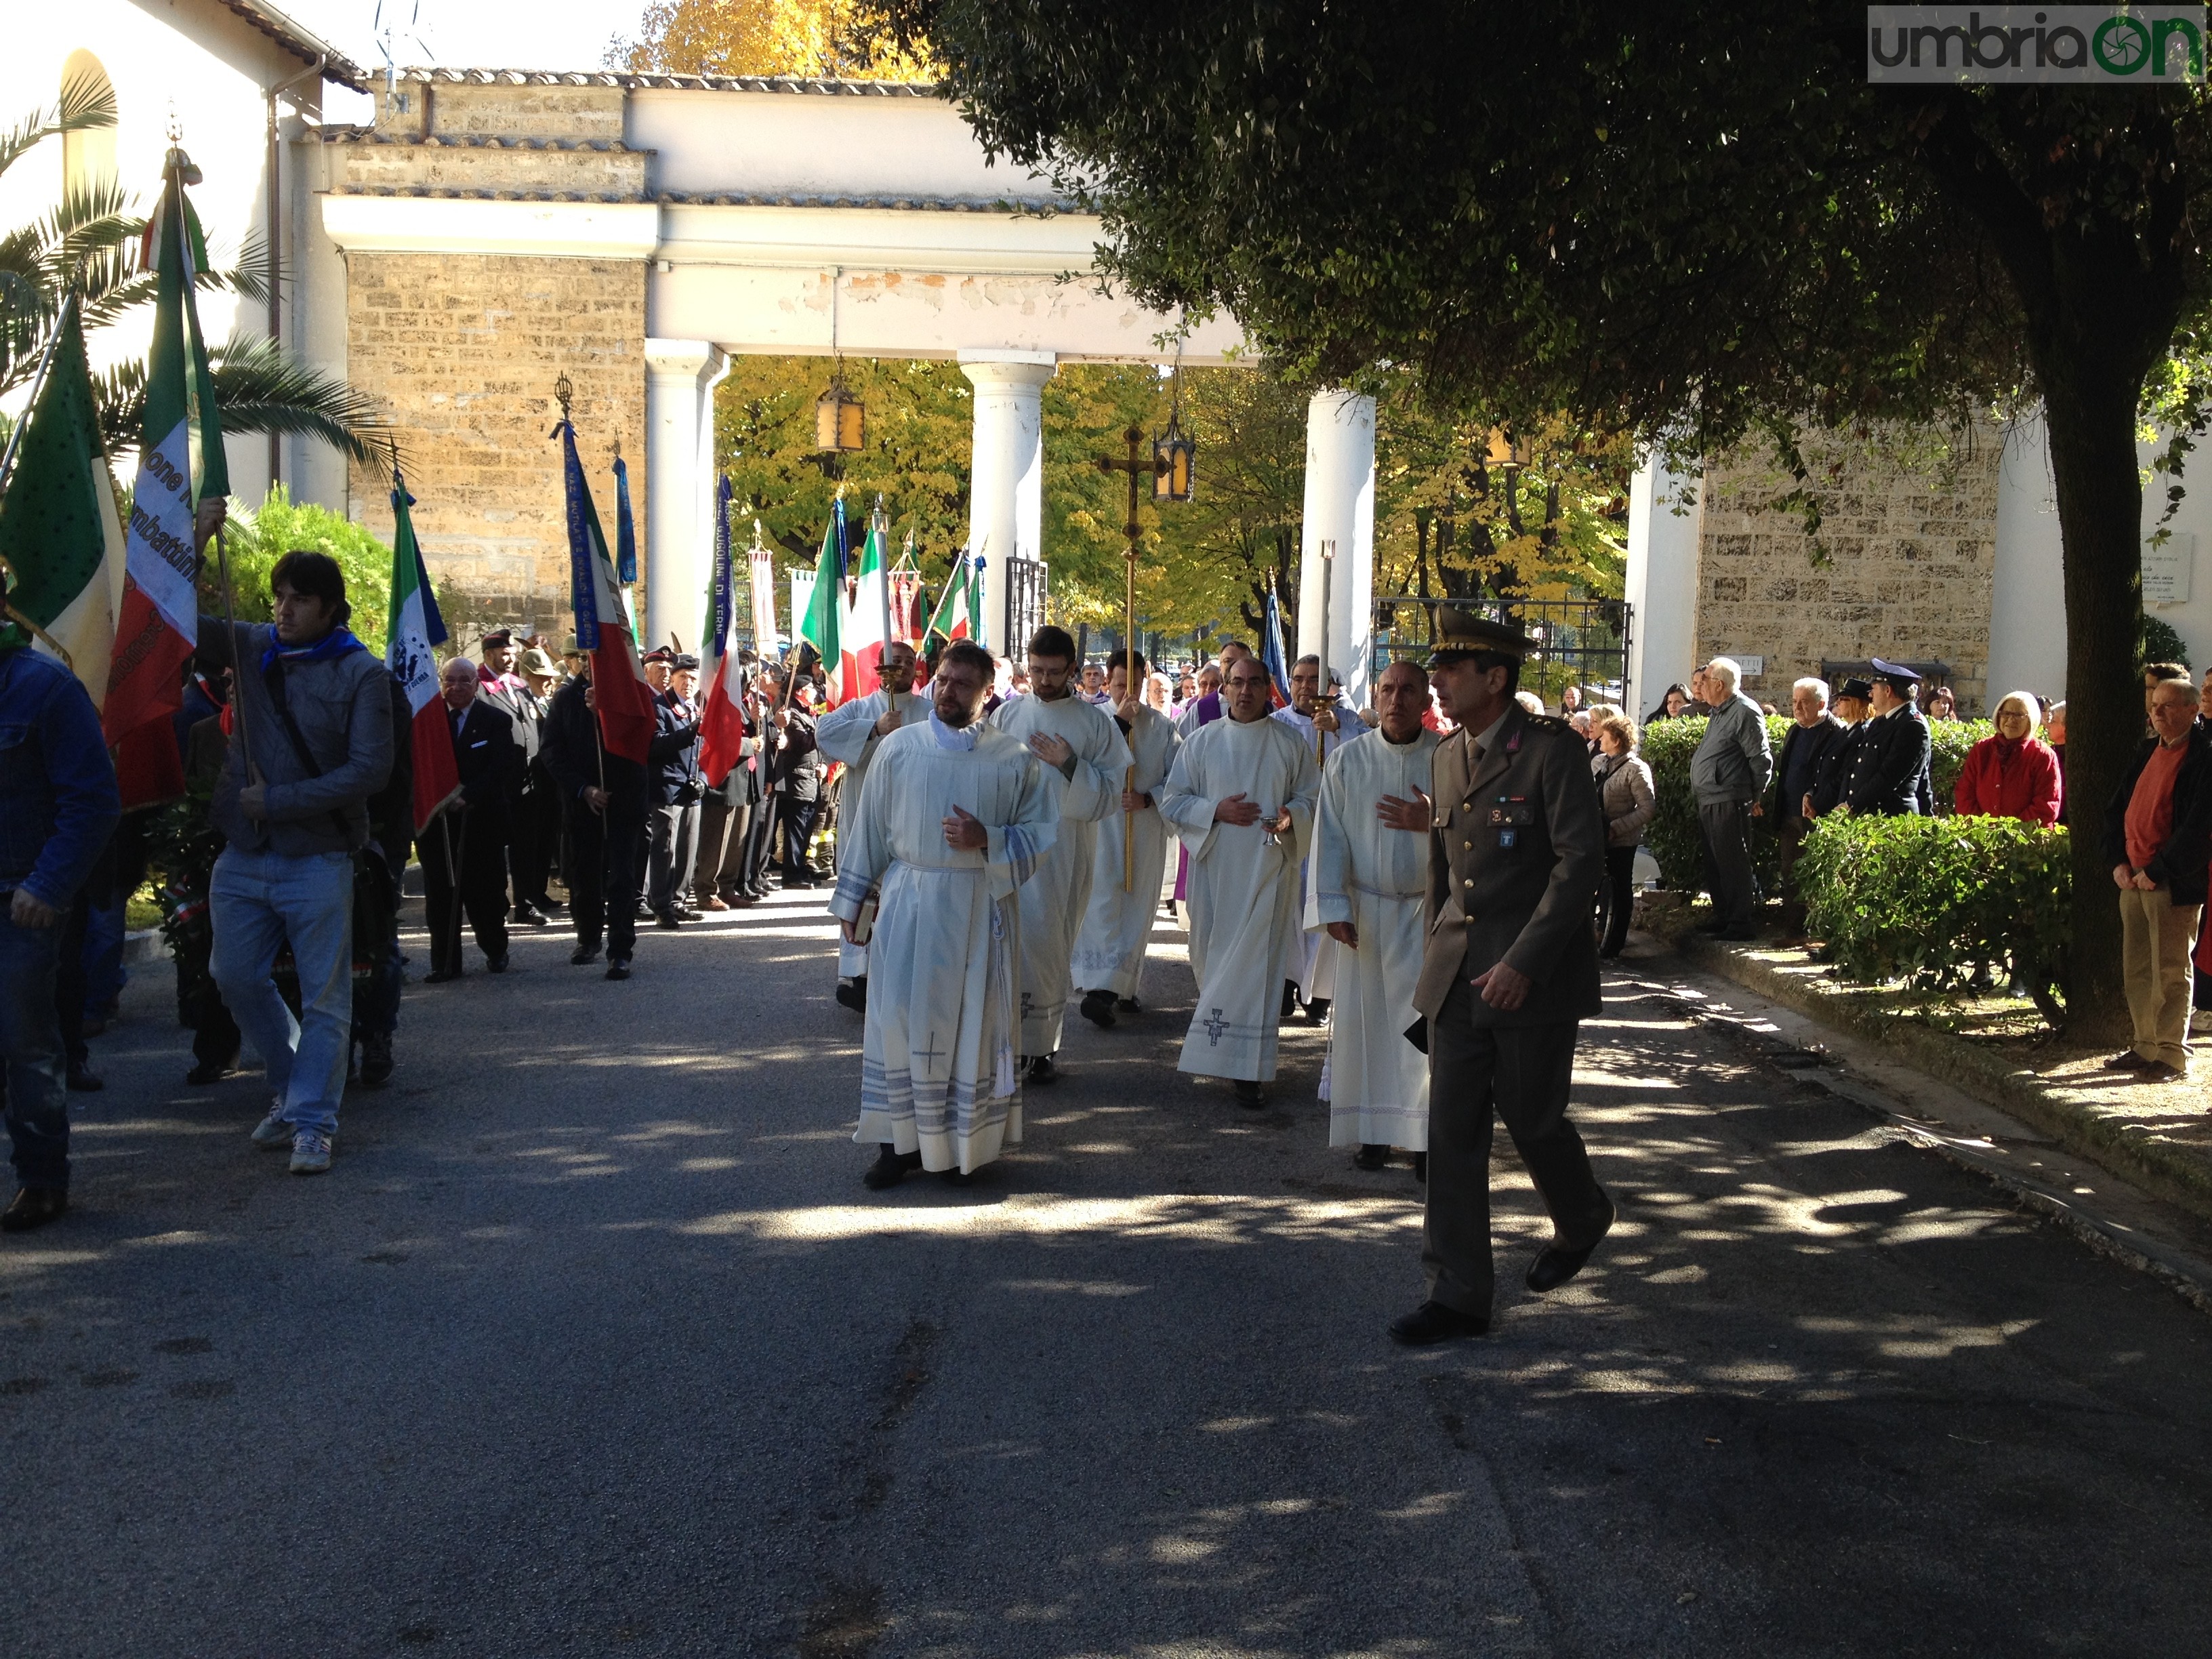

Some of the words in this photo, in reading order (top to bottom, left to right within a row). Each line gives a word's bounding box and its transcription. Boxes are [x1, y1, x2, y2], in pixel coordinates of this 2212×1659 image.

[145, 447, 184, 491] one
[130, 505, 197, 583] mbattim
[576, 557, 588, 594] INVALIDI
[715, 583, 724, 596] DI
[581, 597, 589, 605] DI
[716, 602, 724, 634] TERNI
[583, 611, 593, 646] GUERRA
